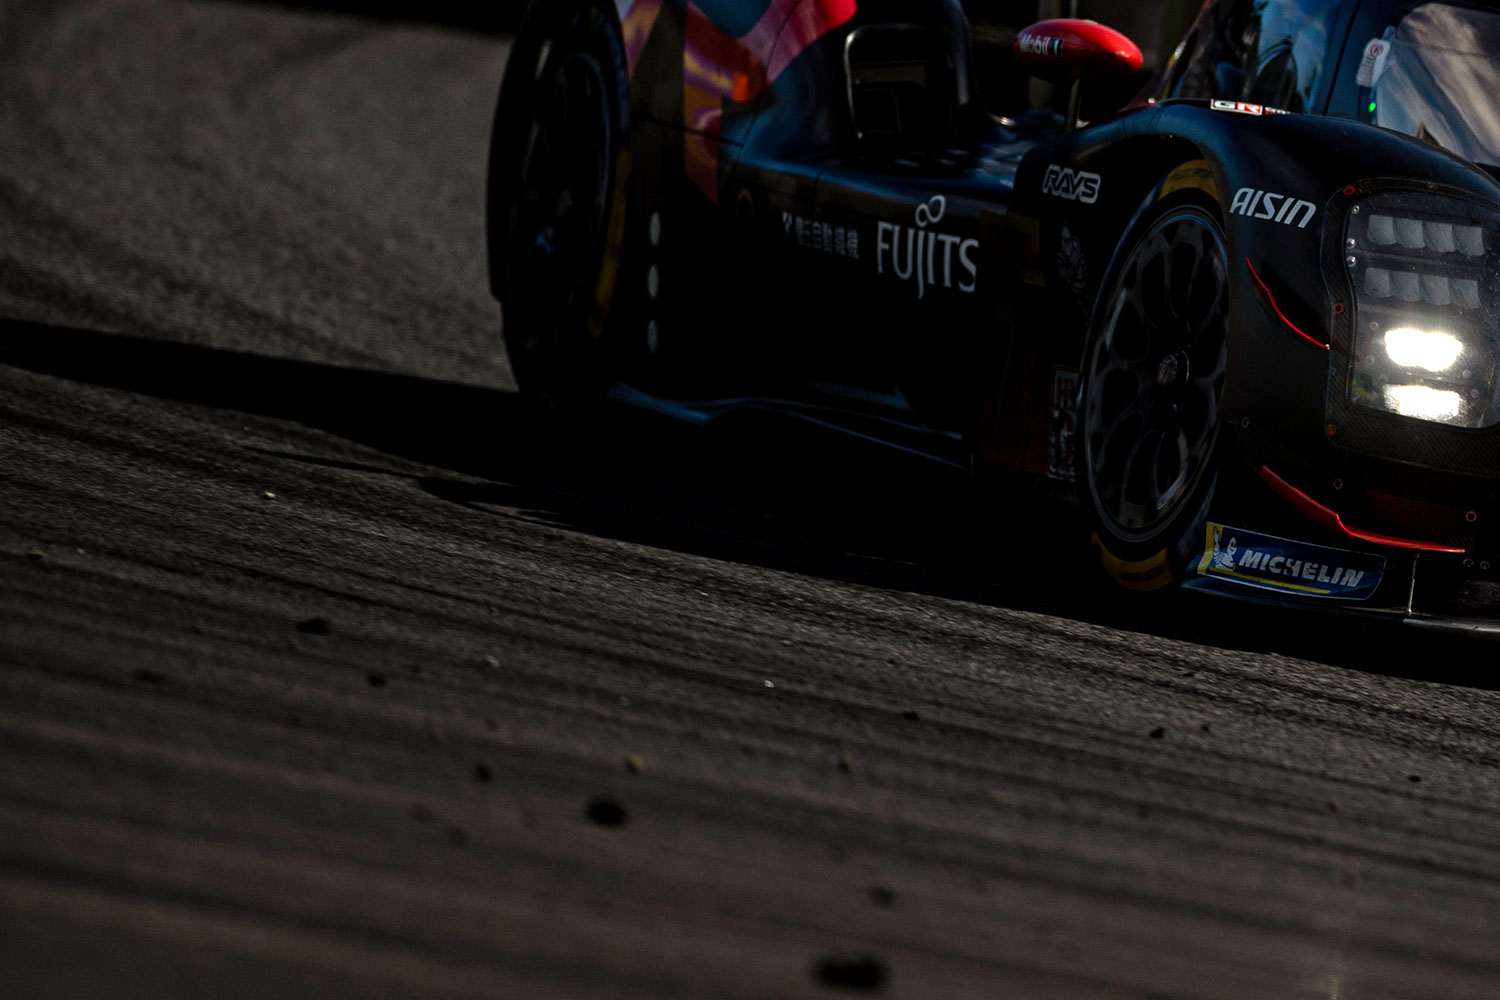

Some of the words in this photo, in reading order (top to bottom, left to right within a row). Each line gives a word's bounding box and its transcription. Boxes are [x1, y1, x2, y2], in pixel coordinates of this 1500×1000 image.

[1042, 163, 1101, 204] RAYS
[1229, 187, 1317, 229] AISIN
[876, 195, 980, 301] FUJITS
[1238, 549, 1365, 588] MICHELIN
